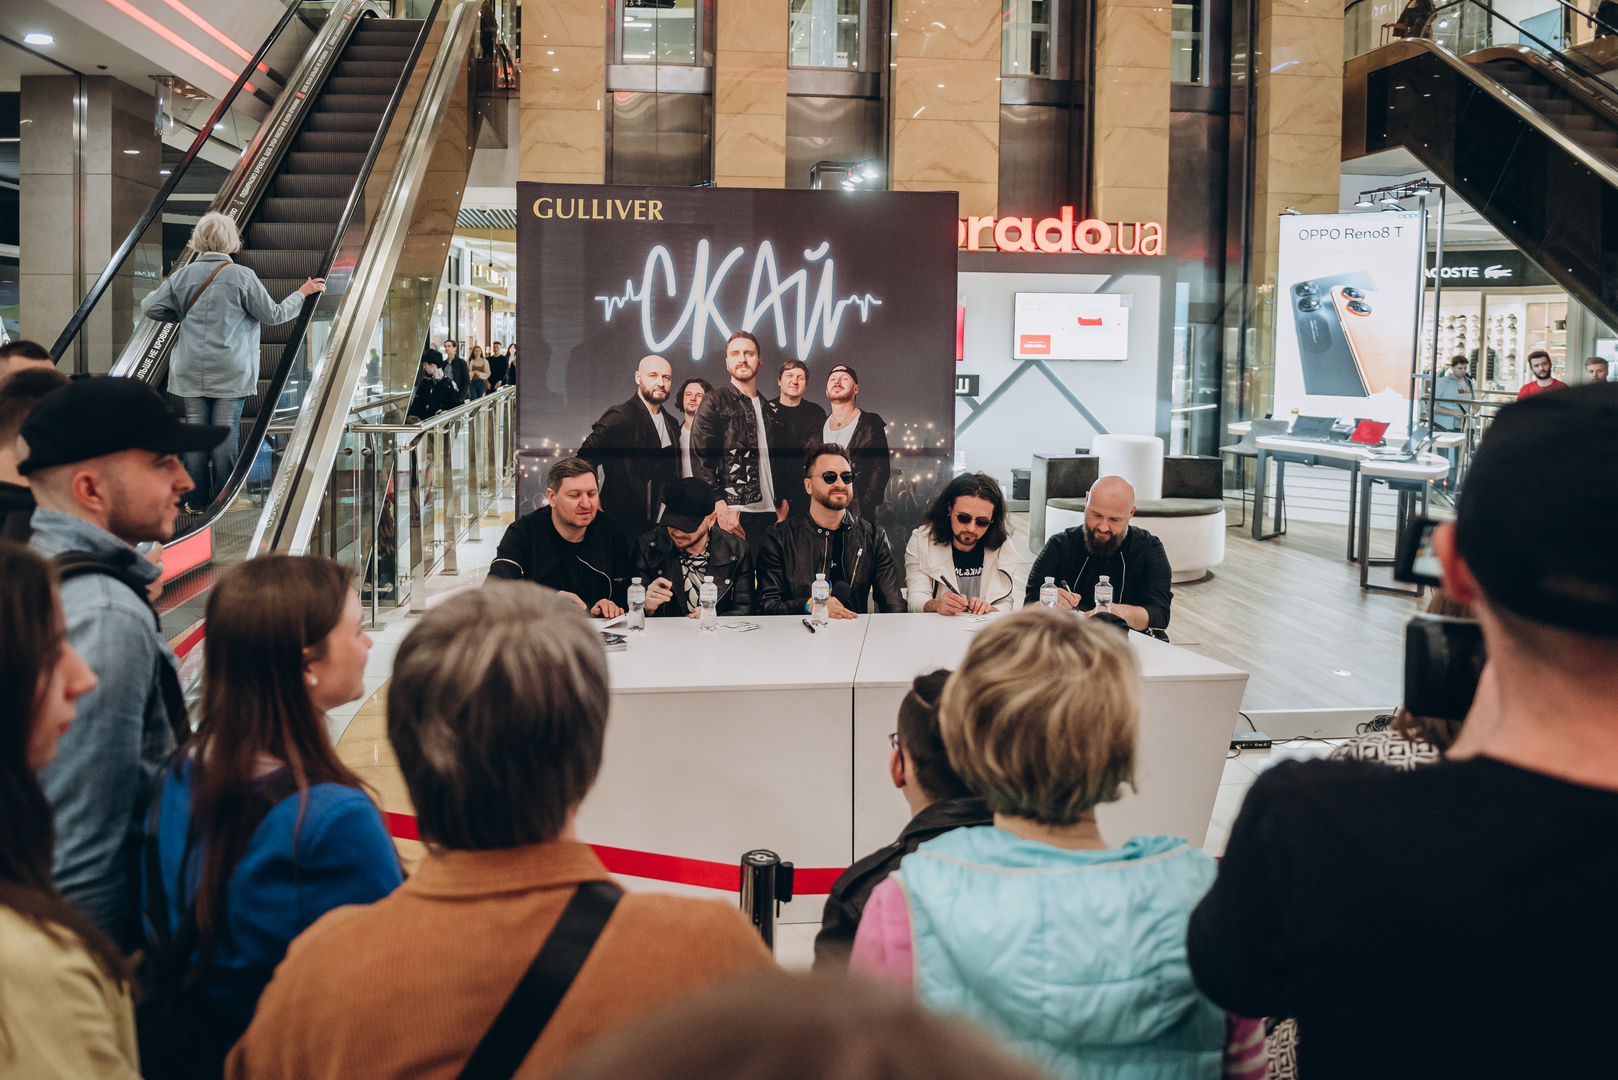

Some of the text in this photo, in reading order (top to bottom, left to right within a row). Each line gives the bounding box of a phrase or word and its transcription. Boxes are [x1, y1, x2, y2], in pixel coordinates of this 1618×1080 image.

[532, 197, 664, 221] GULLIVER
[1298, 226, 1404, 241] OPPO Reno8 T
[1425, 266, 1480, 278] ACOSTE
[640, 238, 842, 361] СКАЙ
[137, 322, 174, 380] ІЛЬШЕ НЕ КРОВИЛИ
